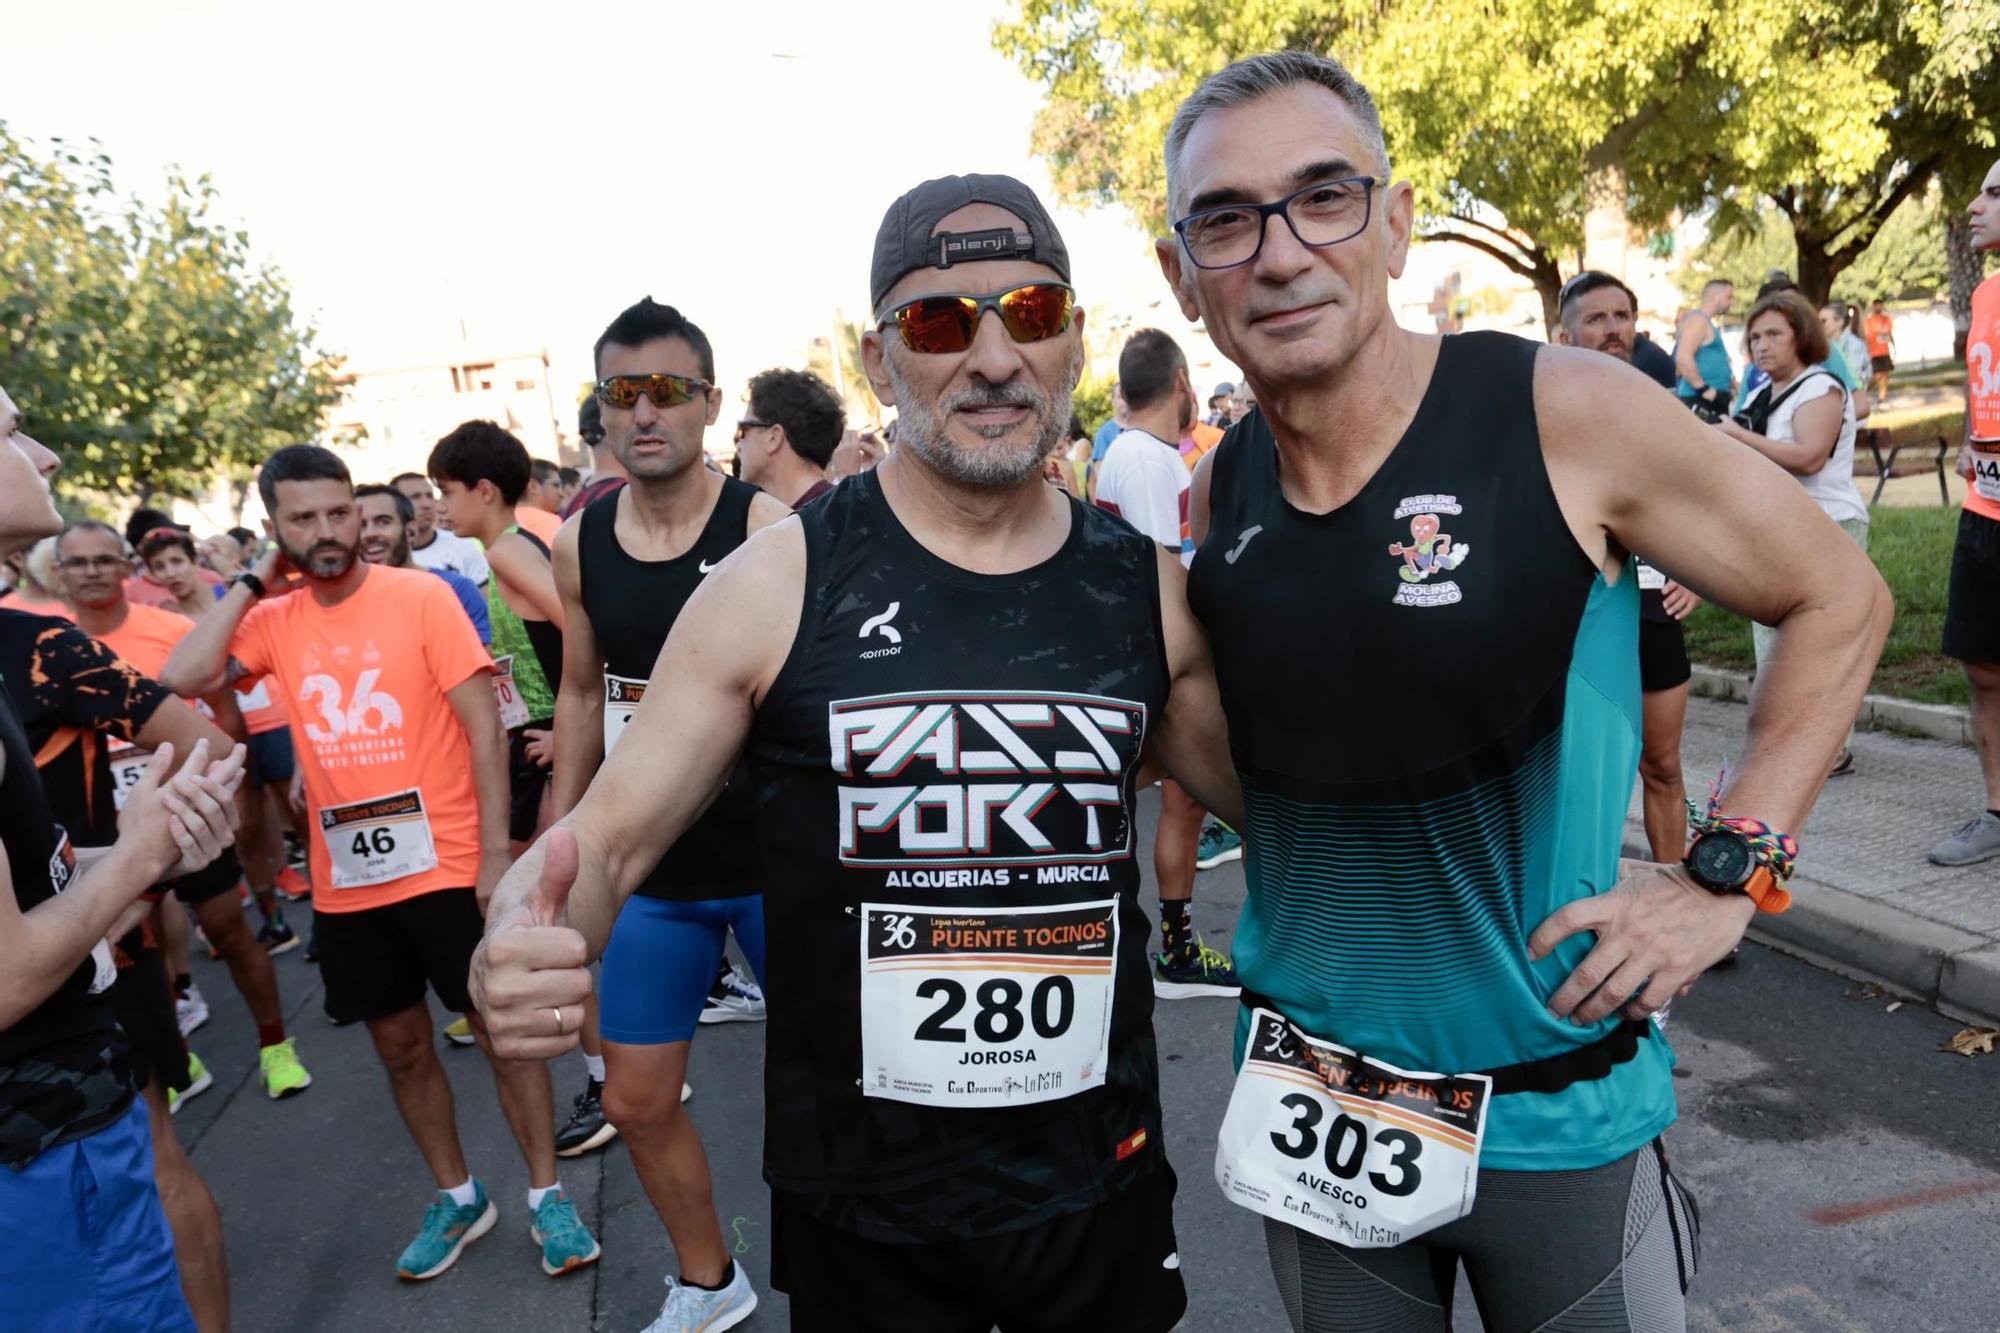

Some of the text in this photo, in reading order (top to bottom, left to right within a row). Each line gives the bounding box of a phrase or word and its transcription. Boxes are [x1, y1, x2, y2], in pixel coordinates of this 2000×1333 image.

[945, 235, 1007, 251] alenji
[1395, 503, 1460, 516] ATLETISMO
[1401, 496, 1456, 507] CLUB DE
[1395, 593, 1460, 604] AVESCO
[1401, 583, 1456, 595] MOLINA
[299, 667, 404, 745] 36
[829, 703, 1132, 777] PASS
[838, 784, 1122, 854] PORT
[352, 827, 396, 858] 46
[885, 868, 1010, 888] ALQUERIAS
[1037, 865, 1110, 885] MURCIA
[882, 914, 917, 949] 36
[932, 921, 1107, 948] PUENTE TOCINOS
[914, 974, 1075, 1043] 280
[958, 1049, 1037, 1065] JOROSA
[1270, 1093, 1423, 1197] 303
[1296, 1171, 1367, 1209] AVESCO
